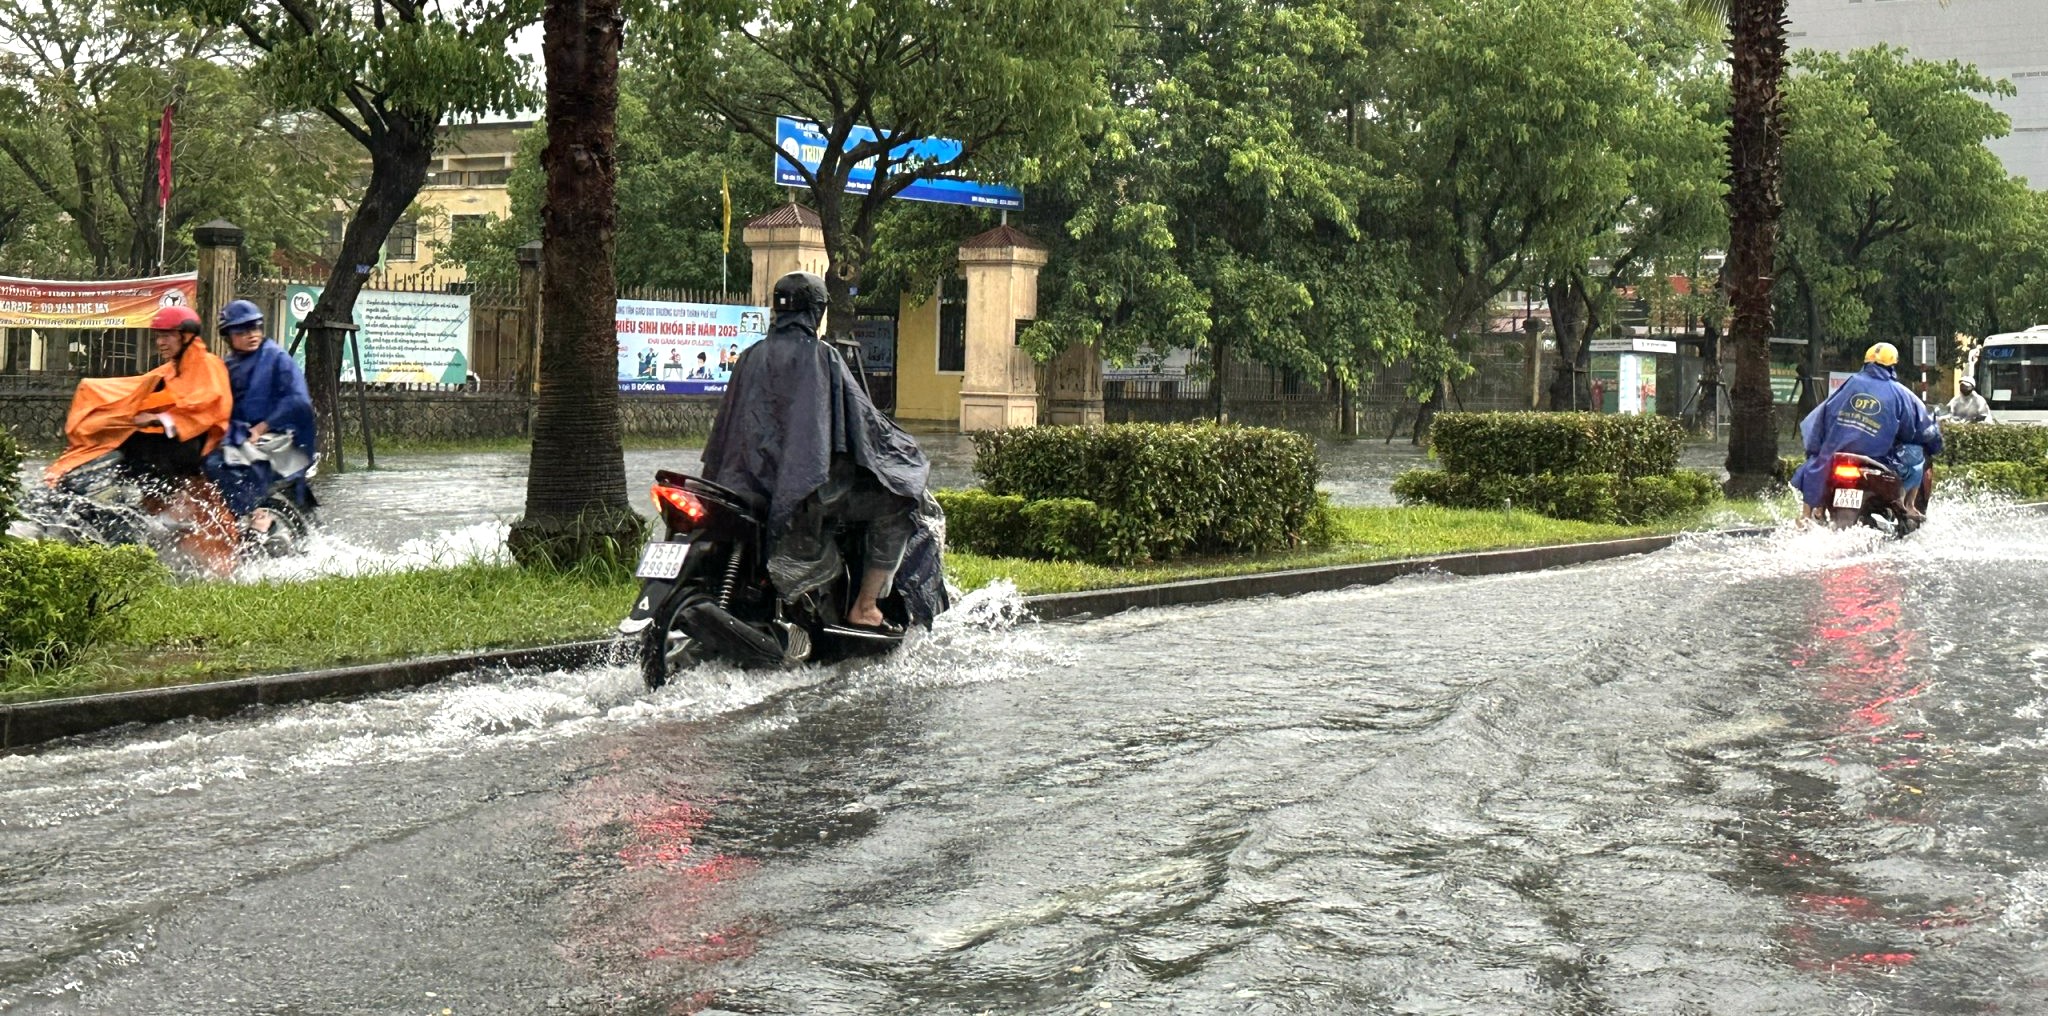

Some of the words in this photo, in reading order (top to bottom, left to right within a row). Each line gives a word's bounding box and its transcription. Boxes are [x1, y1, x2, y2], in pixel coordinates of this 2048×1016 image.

[638, 321, 658, 334] SINH
[660, 320, 683, 335] KHÓA
[686, 321, 696, 336] HÈ
[698, 322, 716, 337] NĂM
[718, 325, 738, 337] 2025
